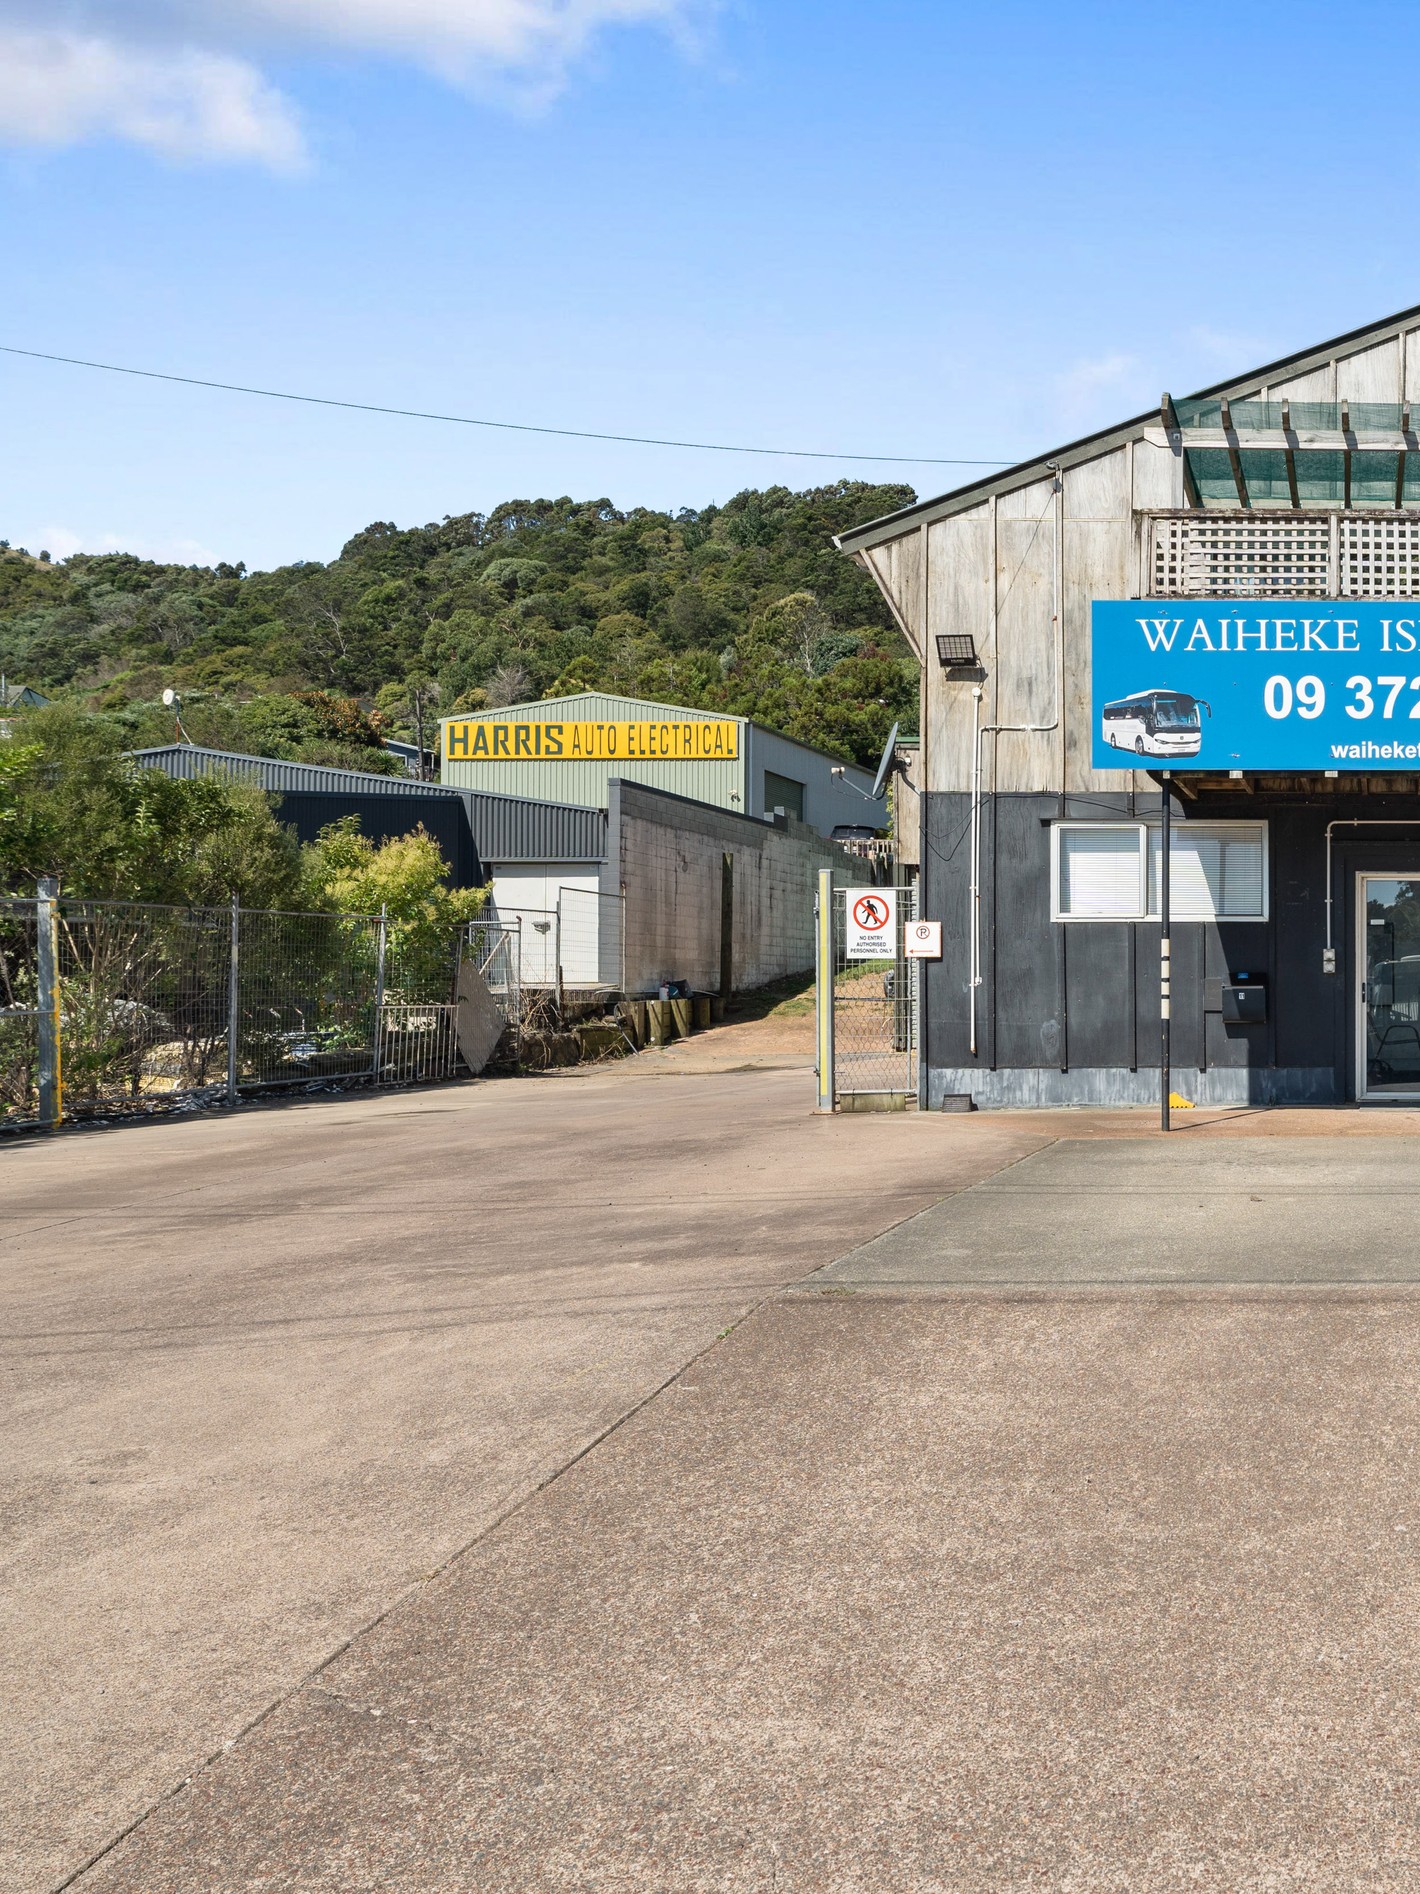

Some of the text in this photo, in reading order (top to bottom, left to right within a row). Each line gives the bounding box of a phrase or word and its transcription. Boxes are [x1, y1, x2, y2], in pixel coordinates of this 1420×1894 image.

[1136, 618, 1360, 652] WAIHEKE
[1263, 675, 1326, 720] 09
[449, 724, 734, 756] HARRIS AUTO ELECTRICAL
